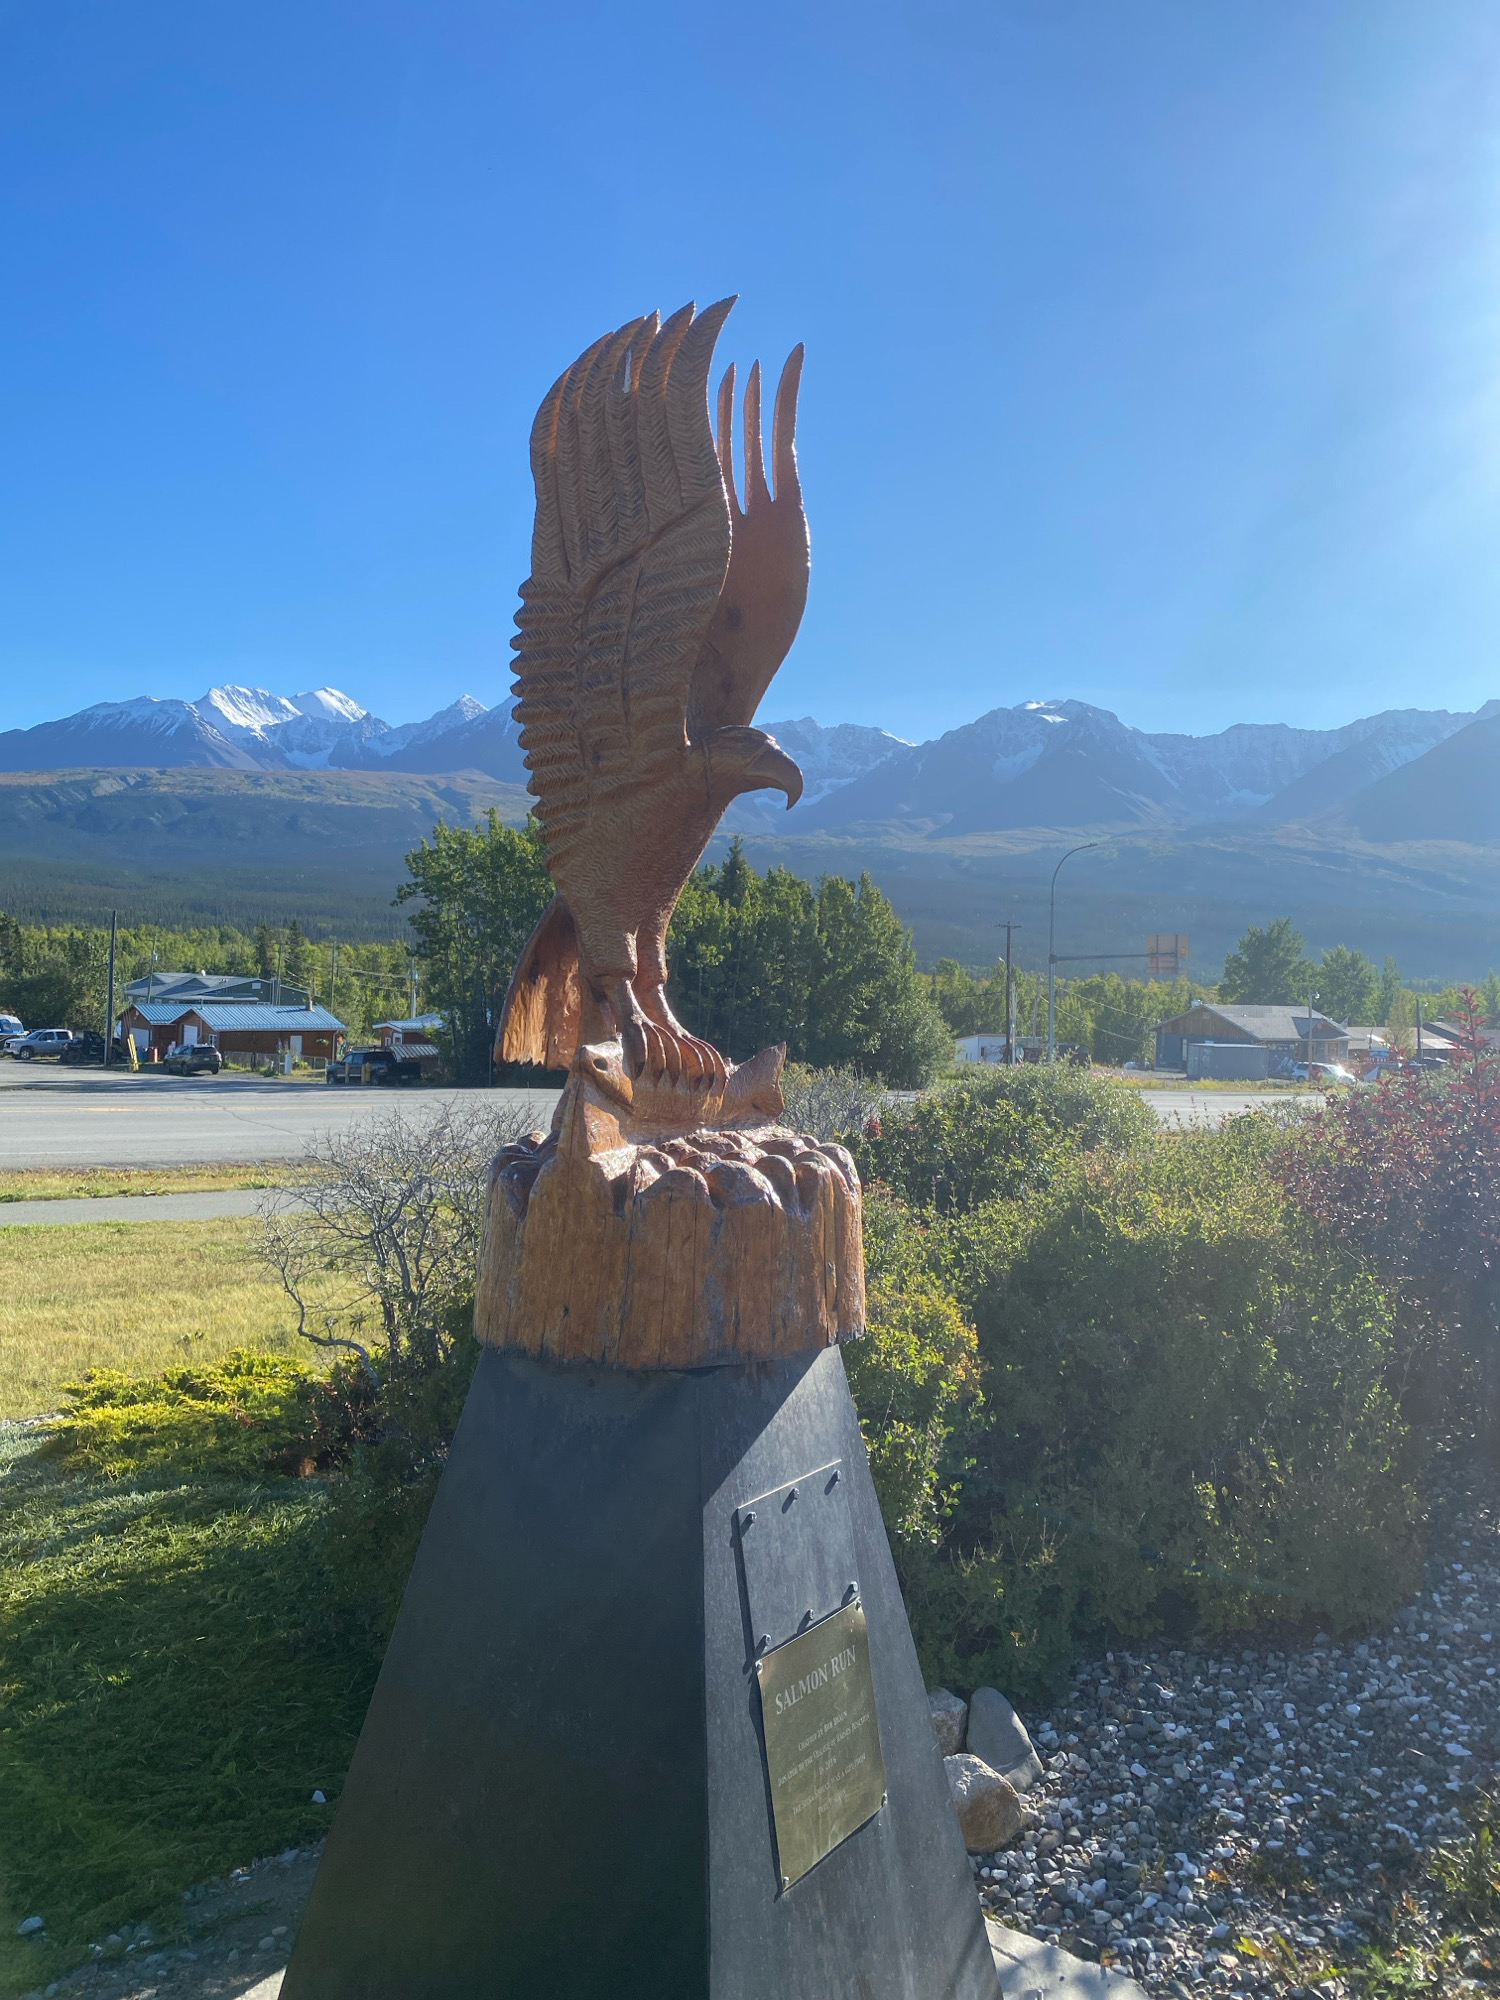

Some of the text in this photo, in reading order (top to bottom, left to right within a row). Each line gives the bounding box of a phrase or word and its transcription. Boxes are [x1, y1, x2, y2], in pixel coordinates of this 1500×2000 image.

[775, 1645, 856, 1715] SALMON RUN
[778, 1766, 798, 1787] DONATED
[805, 1755, 813, 1767] THE
[813, 1741, 830, 1760] VILLAGE
[836, 1726, 851, 1743] HAINES
[852, 1712, 870, 1732] JUNCTION
[793, 1803, 801, 1816] THE
